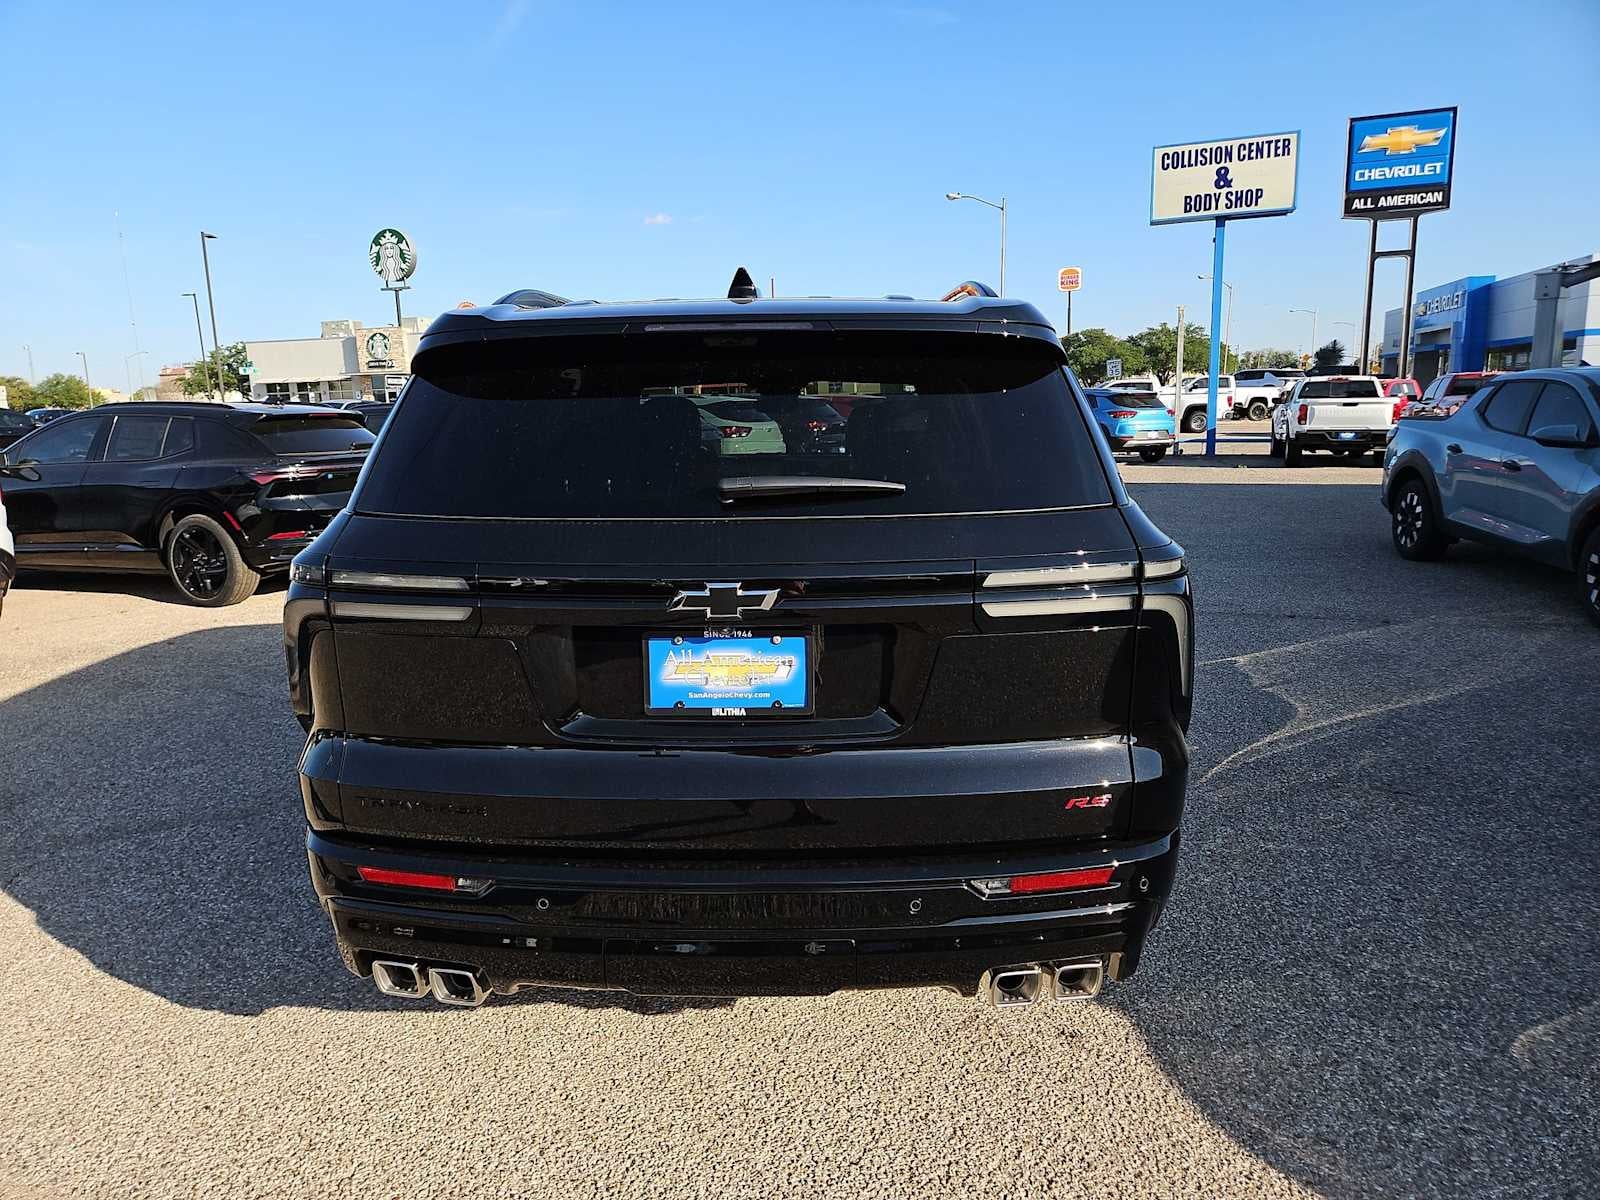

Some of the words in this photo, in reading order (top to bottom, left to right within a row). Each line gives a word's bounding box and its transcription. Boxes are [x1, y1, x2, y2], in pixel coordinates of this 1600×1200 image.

[1161, 145, 1233, 171] COLLISION
[1237, 138, 1291, 162] CENTER
[1214, 166, 1233, 189] &
[1354, 162, 1444, 182] CHEVROLET
[1183, 192, 1221, 213] BODY
[1225, 188, 1264, 209] SHOP
[1351, 198, 1375, 210] ALL
[1378, 191, 1443, 207] AMERICAN
[1109, 368, 1120, 376] 35
[703, 630, 731, 638] SINCE
[733, 630, 752, 638] 1946
[664, 649, 693, 665] All
[1065, 794, 1112, 809] RS
